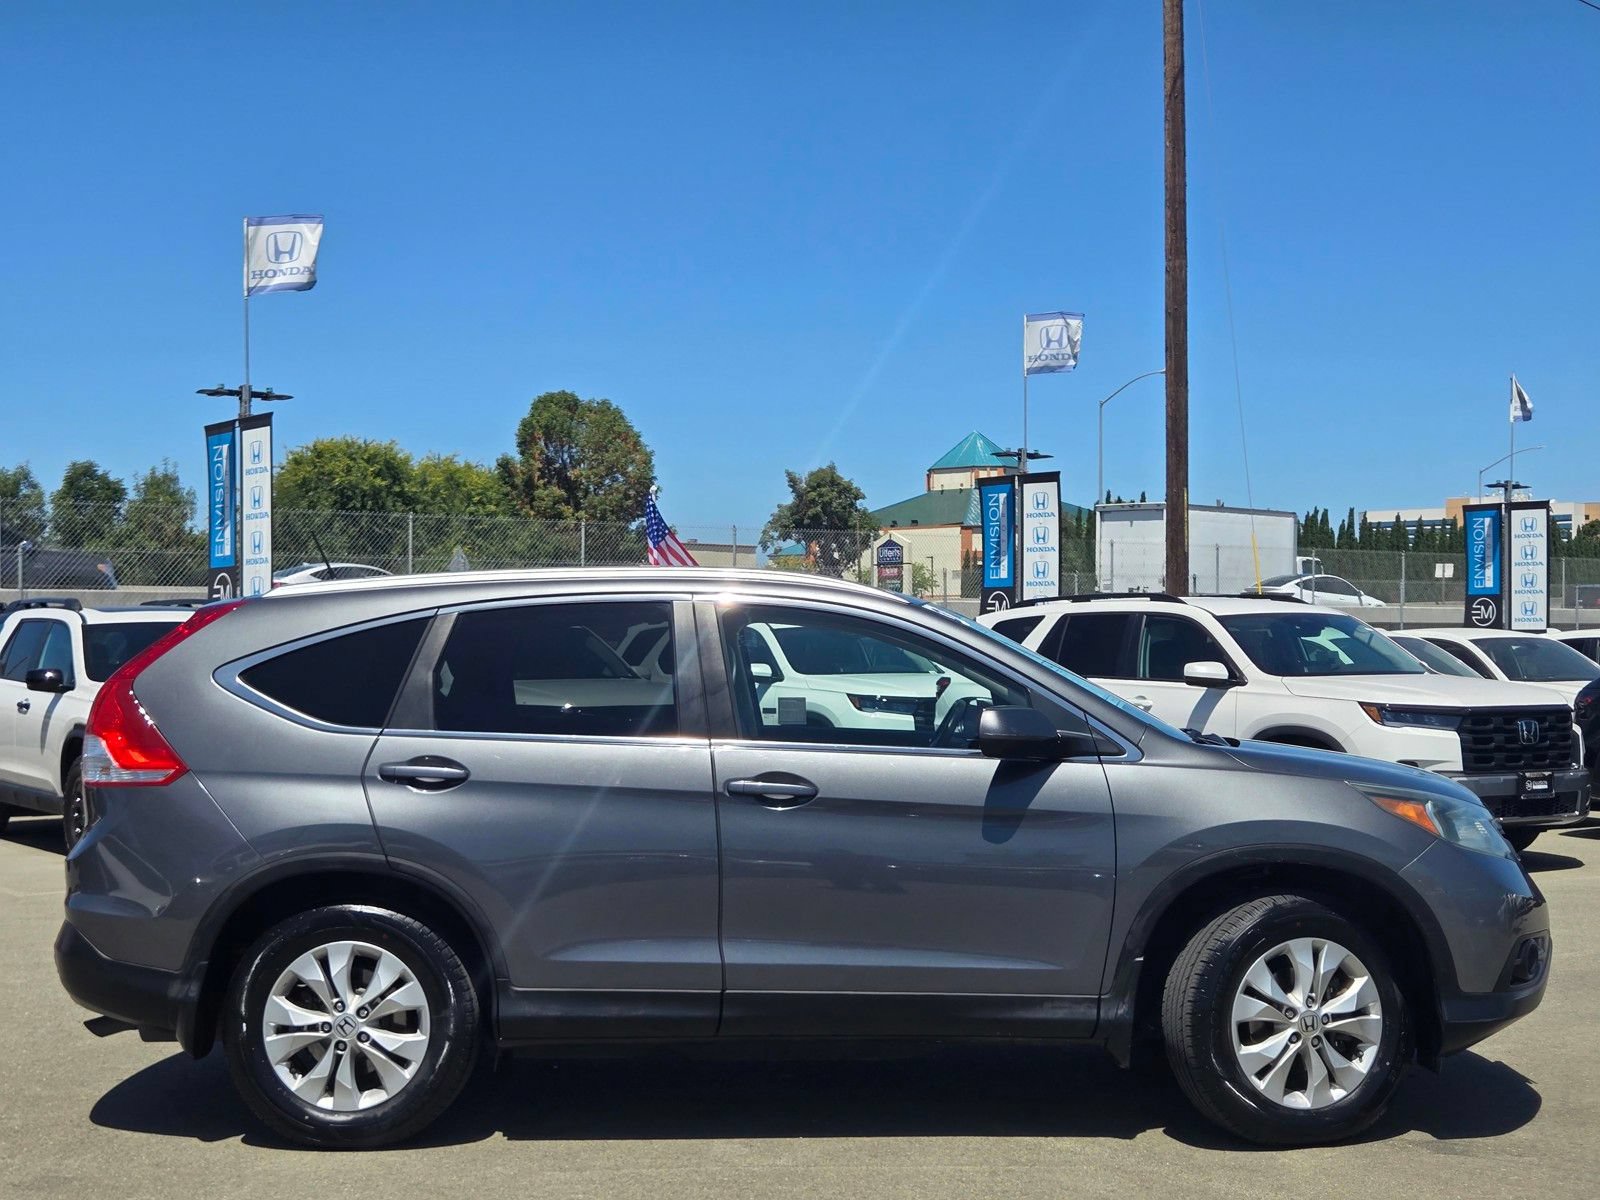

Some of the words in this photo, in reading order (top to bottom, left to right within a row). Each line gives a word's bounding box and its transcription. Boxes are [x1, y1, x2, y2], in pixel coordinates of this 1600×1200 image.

[251, 266, 315, 280] HONDA
[1027, 352, 1073, 363] HOND
[245, 466, 269, 476] HONDA
[213, 445, 224, 557] ENVISION
[245, 511, 269, 521] HONDA
[1026, 511, 1056, 519] HONDA
[988, 493, 1000, 579] ENVISION
[1473, 517, 1484, 588] ENVISION
[245, 557, 269, 566] HONDA
